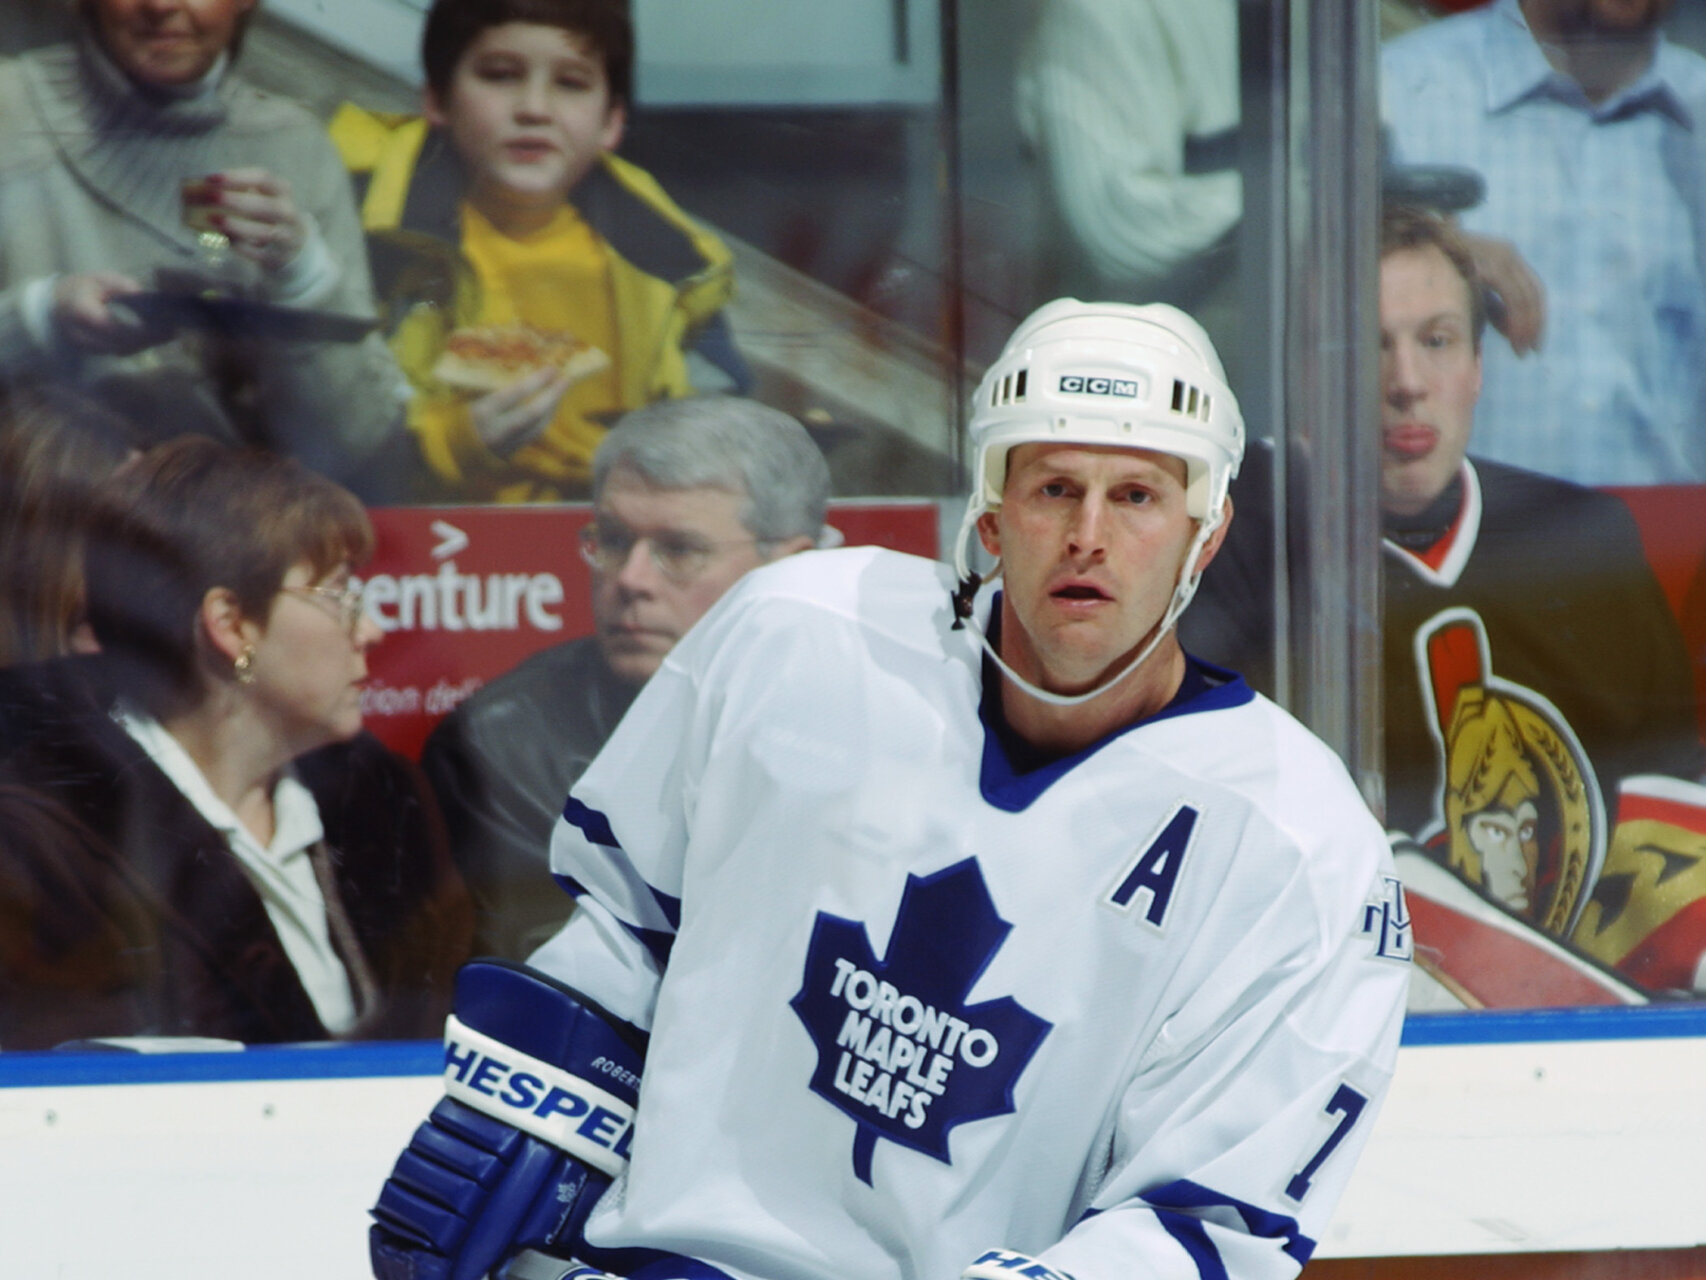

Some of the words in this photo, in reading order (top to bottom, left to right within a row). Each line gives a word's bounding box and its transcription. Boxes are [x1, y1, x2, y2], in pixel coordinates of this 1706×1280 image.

[1061, 377, 1137, 398] CCM
[1110, 804, 1199, 927] A
[830, 957, 999, 1068] TORONTO
[836, 1010, 954, 1096] MAPLE
[591, 1056, 641, 1092] ROBERT
[834, 1051, 933, 1129] LEAFS
[1284, 1083, 1369, 1202] 7
